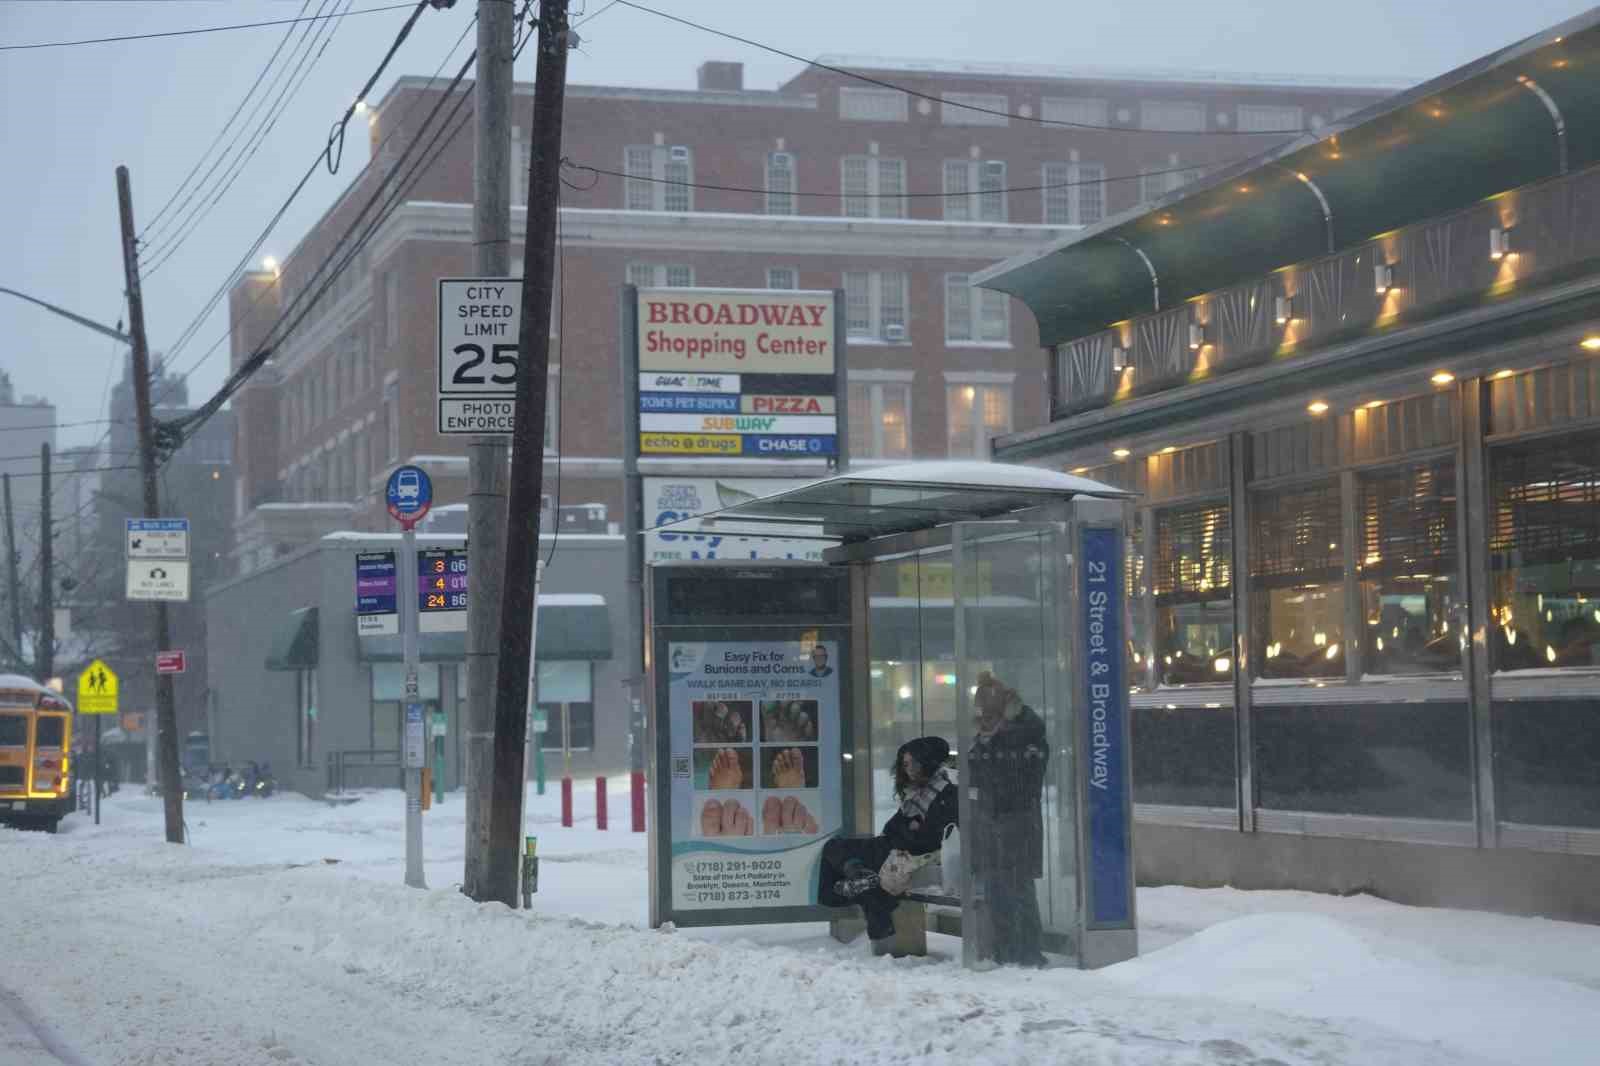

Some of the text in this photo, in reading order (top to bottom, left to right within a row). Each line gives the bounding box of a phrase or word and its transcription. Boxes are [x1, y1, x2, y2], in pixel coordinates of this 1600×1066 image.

[466, 286, 505, 300] CITY
[458, 304, 513, 318] SPEED
[646, 301, 827, 327] BROADWAY
[463, 323, 508, 336] LIMIT
[647, 330, 827, 360] Shopping Center
[452, 343, 519, 385] 25
[696, 376, 724, 388] TIME
[462, 403, 512, 415] PHOTO
[675, 397, 695, 409] PET
[696, 397, 737, 409] SUPPLY
[752, 397, 822, 413] PIZZA
[447, 416, 515, 428] ENFORCE
[701, 417, 776, 431] SUBWAY
[644, 436, 680, 448] echo
[696, 436, 737, 451] drugs
[758, 439, 808, 451] CHASE
[434, 559, 445, 573] 3
[435, 577, 446, 590] 4
[427, 594, 446, 608] 24
[724, 651, 784, 664] Easy Fix for
[704, 663, 805, 674] Bunions and Corns
[1088, 561, 1111, 790] 21 Street & Broadway
[687, 680, 717, 689] WALK
[696, 862, 724, 873] (718)
[698, 891, 726, 903] (718)
